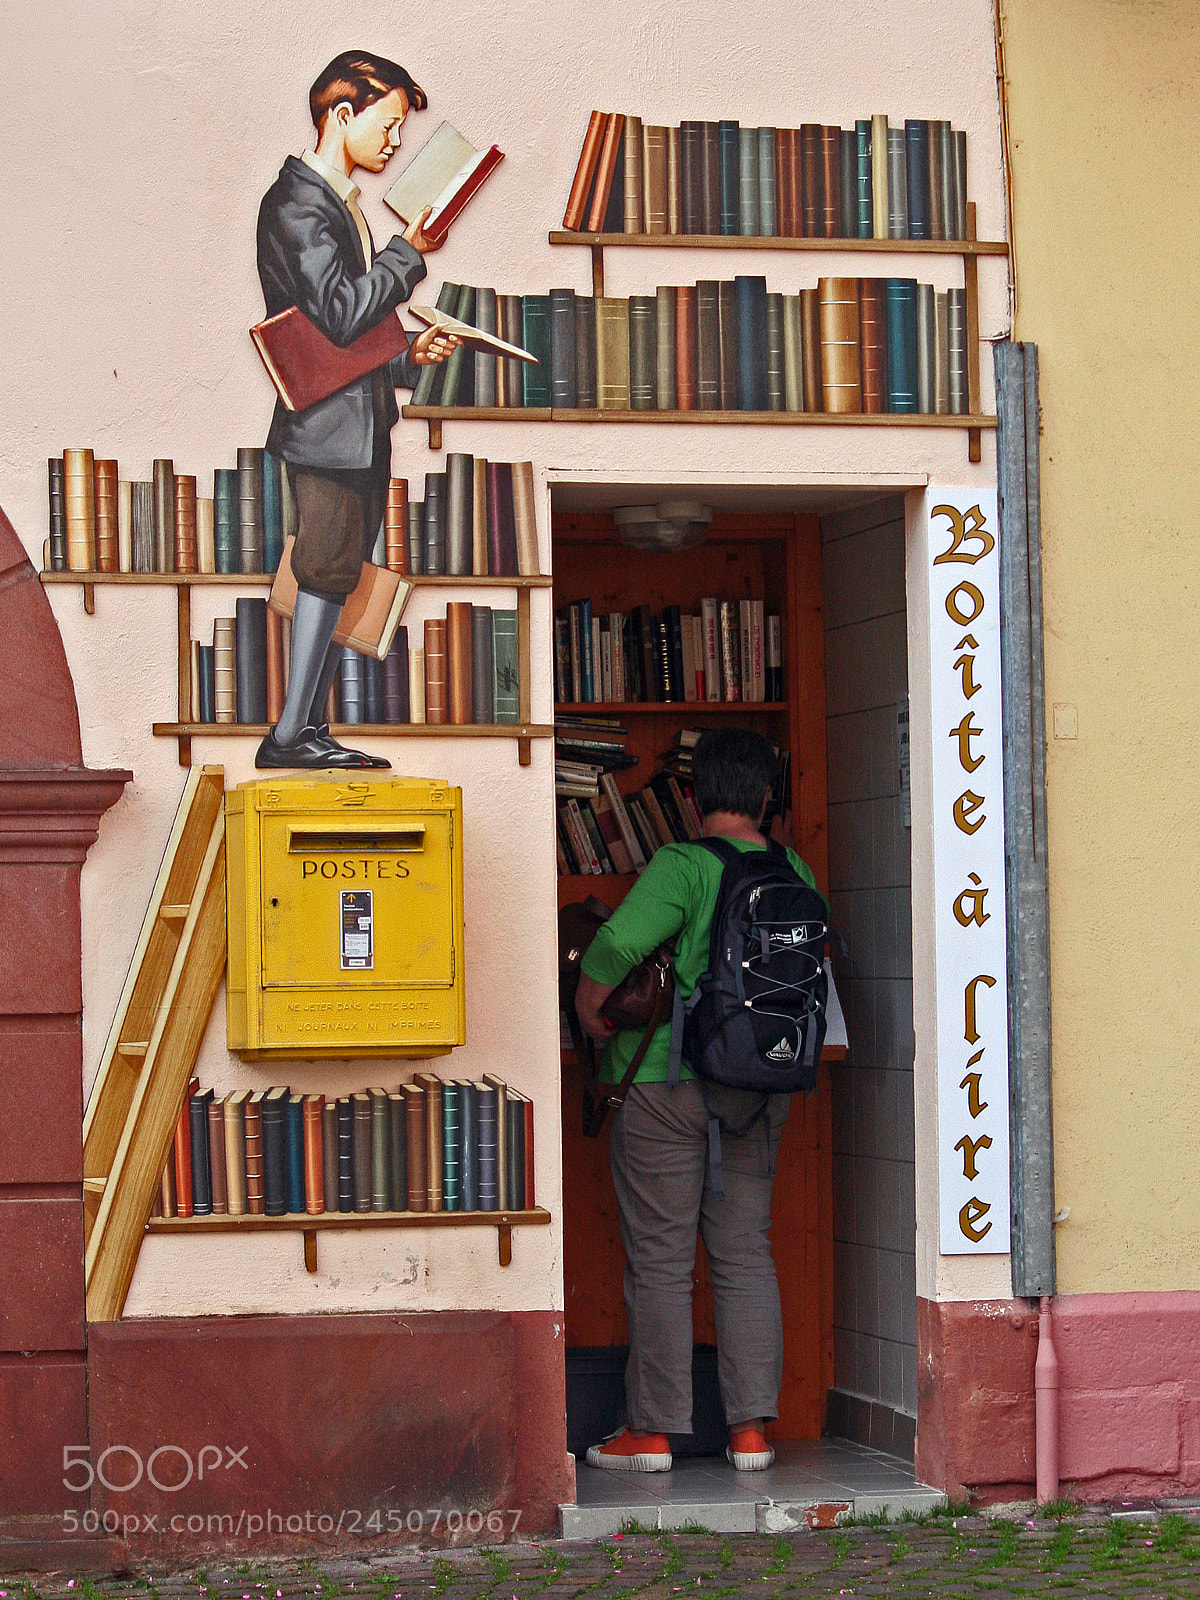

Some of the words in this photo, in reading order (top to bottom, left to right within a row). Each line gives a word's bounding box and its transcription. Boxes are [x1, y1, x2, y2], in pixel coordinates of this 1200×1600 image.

[930, 504, 995, 835] Boîte
[302, 860, 410, 879] POSTES
[952, 872, 991, 928] à
[287, 1003, 300, 1011] NE
[303, 1002, 333, 1011] JETER
[337, 1002, 362, 1011] DANS
[368, 1001, 399, 1011] CETTE
[402, 1001, 429, 1010] BOITE
[276, 1024, 287, 1033] NI
[298, 1021, 358, 1032] JOURNAUX
[367, 1022, 378, 1031] NI
[387, 1020, 441, 1030] IMPRIMES
